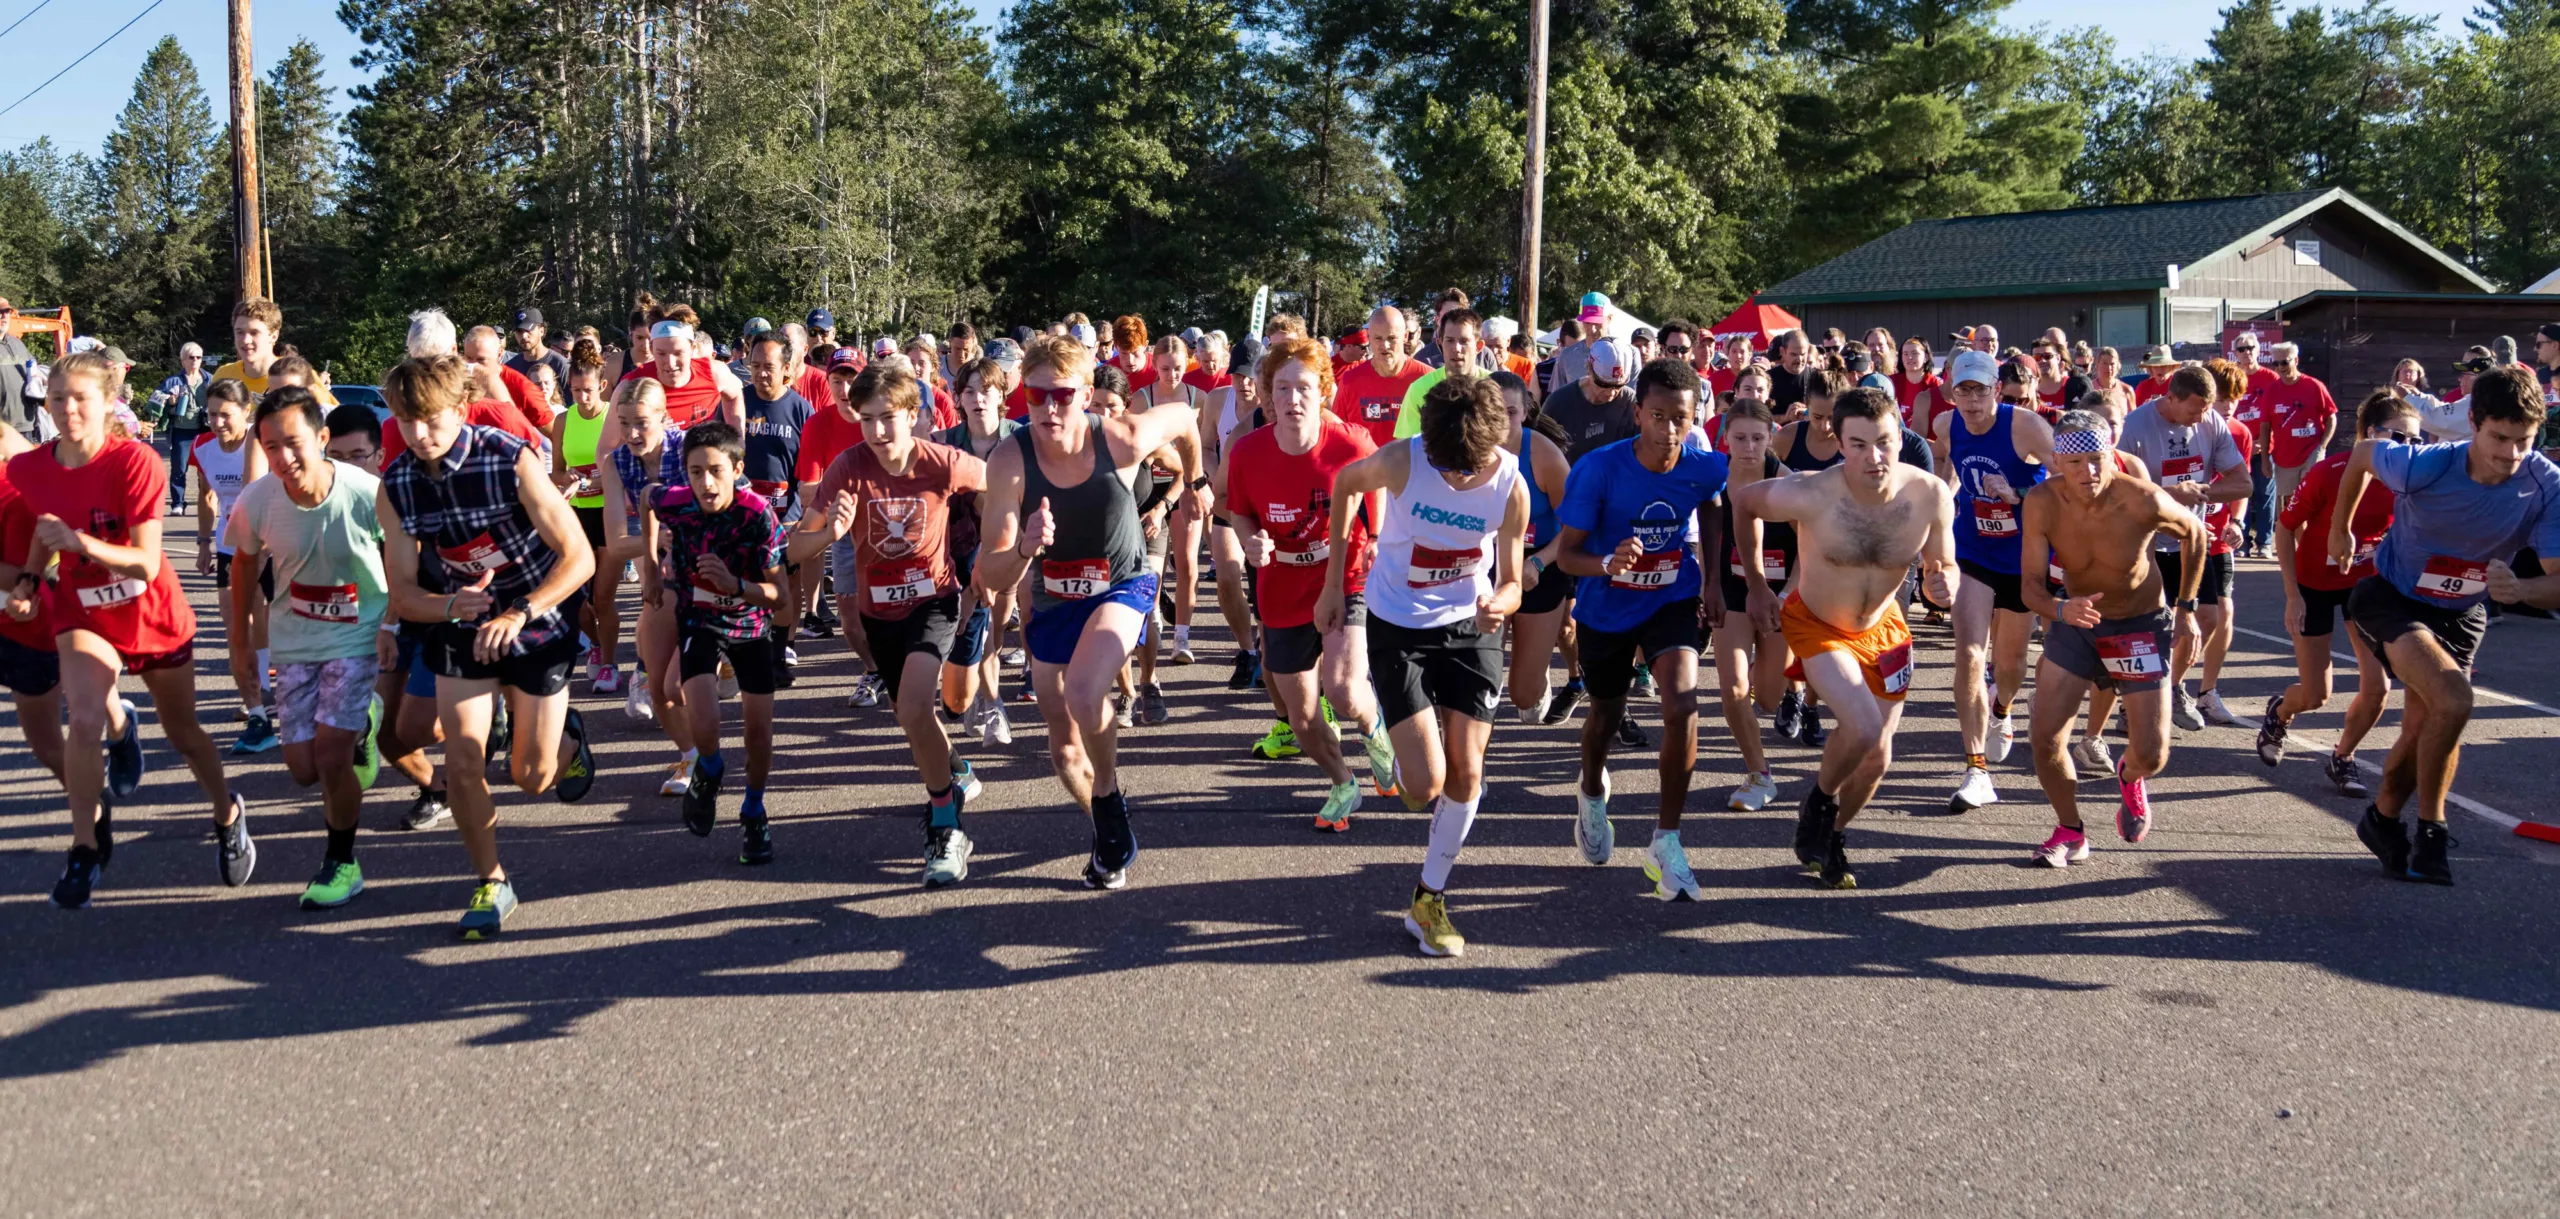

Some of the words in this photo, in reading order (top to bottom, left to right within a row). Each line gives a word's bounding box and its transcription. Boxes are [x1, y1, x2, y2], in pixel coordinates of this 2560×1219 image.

[749, 421, 792, 438] RAGNAR
[1586, 422, 1604, 439] RUN
[2170, 450, 2189, 458] RUN
[1962, 456, 1976, 466] TWIN
[1977, 456, 2000, 469] CITIES
[1411, 502, 1465, 530] HOKA
[1465, 515, 1486, 525] ONE
[1465, 523, 1486, 532] ONE
[1979, 520, 2003, 531] 190
[1296, 553, 1314, 563] 40
[462, 561, 485, 573] 18
[1428, 569, 1462, 580] 109
[1632, 573, 1662, 584] 110
[1061, 580, 1092, 594] 173
[2440, 578, 2464, 593] 49
[94, 584, 127, 603] 171
[886, 585, 918, 601] 275
[714, 595, 734, 606] 36
[310, 603, 340, 616] 170
[2117, 658, 2144, 672] 174
